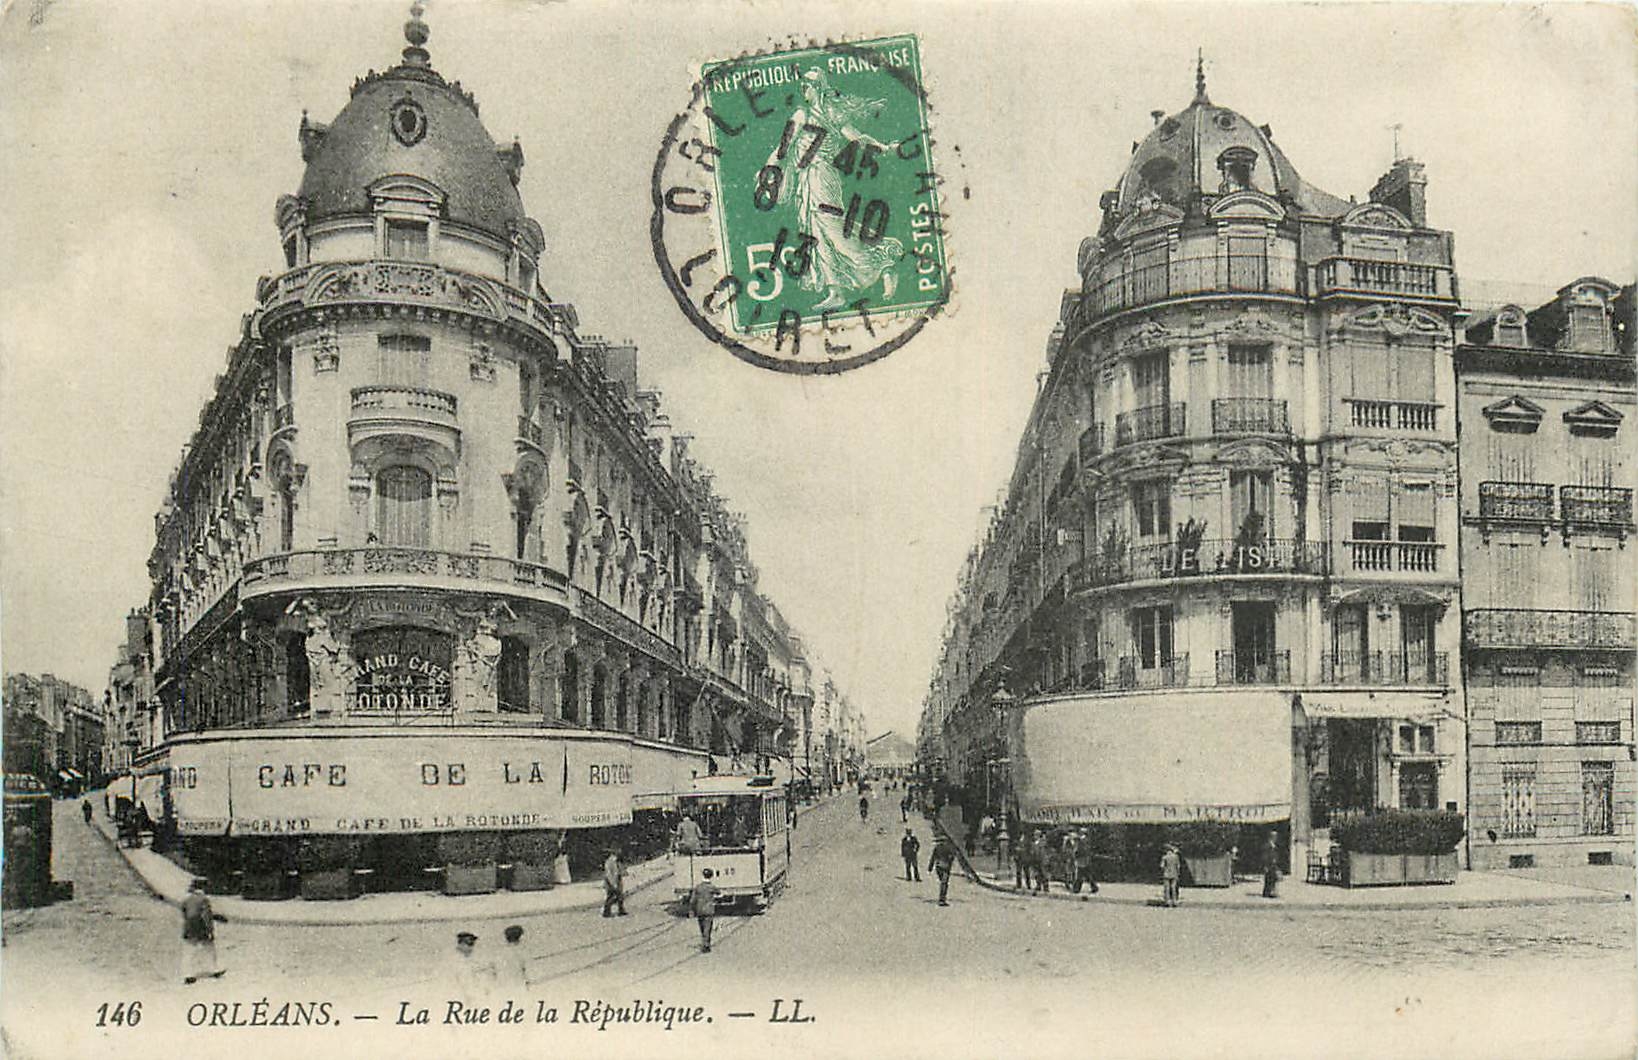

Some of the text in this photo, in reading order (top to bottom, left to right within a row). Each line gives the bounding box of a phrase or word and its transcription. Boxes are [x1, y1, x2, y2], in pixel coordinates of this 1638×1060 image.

[776, 119, 827, 169] 17
[754, 164, 784, 212] 8
[910, 202, 938, 292] POSTES
[358, 692, 448, 710] OTONDE
[258, 764, 347, 788] CAFE
[422, 763, 467, 785] DE
[503, 762, 544, 784] LA
[589, 764, 633, 785] ROTON
[252, 818, 311, 832] GRAND
[337, 817, 390, 830] CAFE
[400, 818, 423, 829] DE
[434, 816, 455, 827] LA
